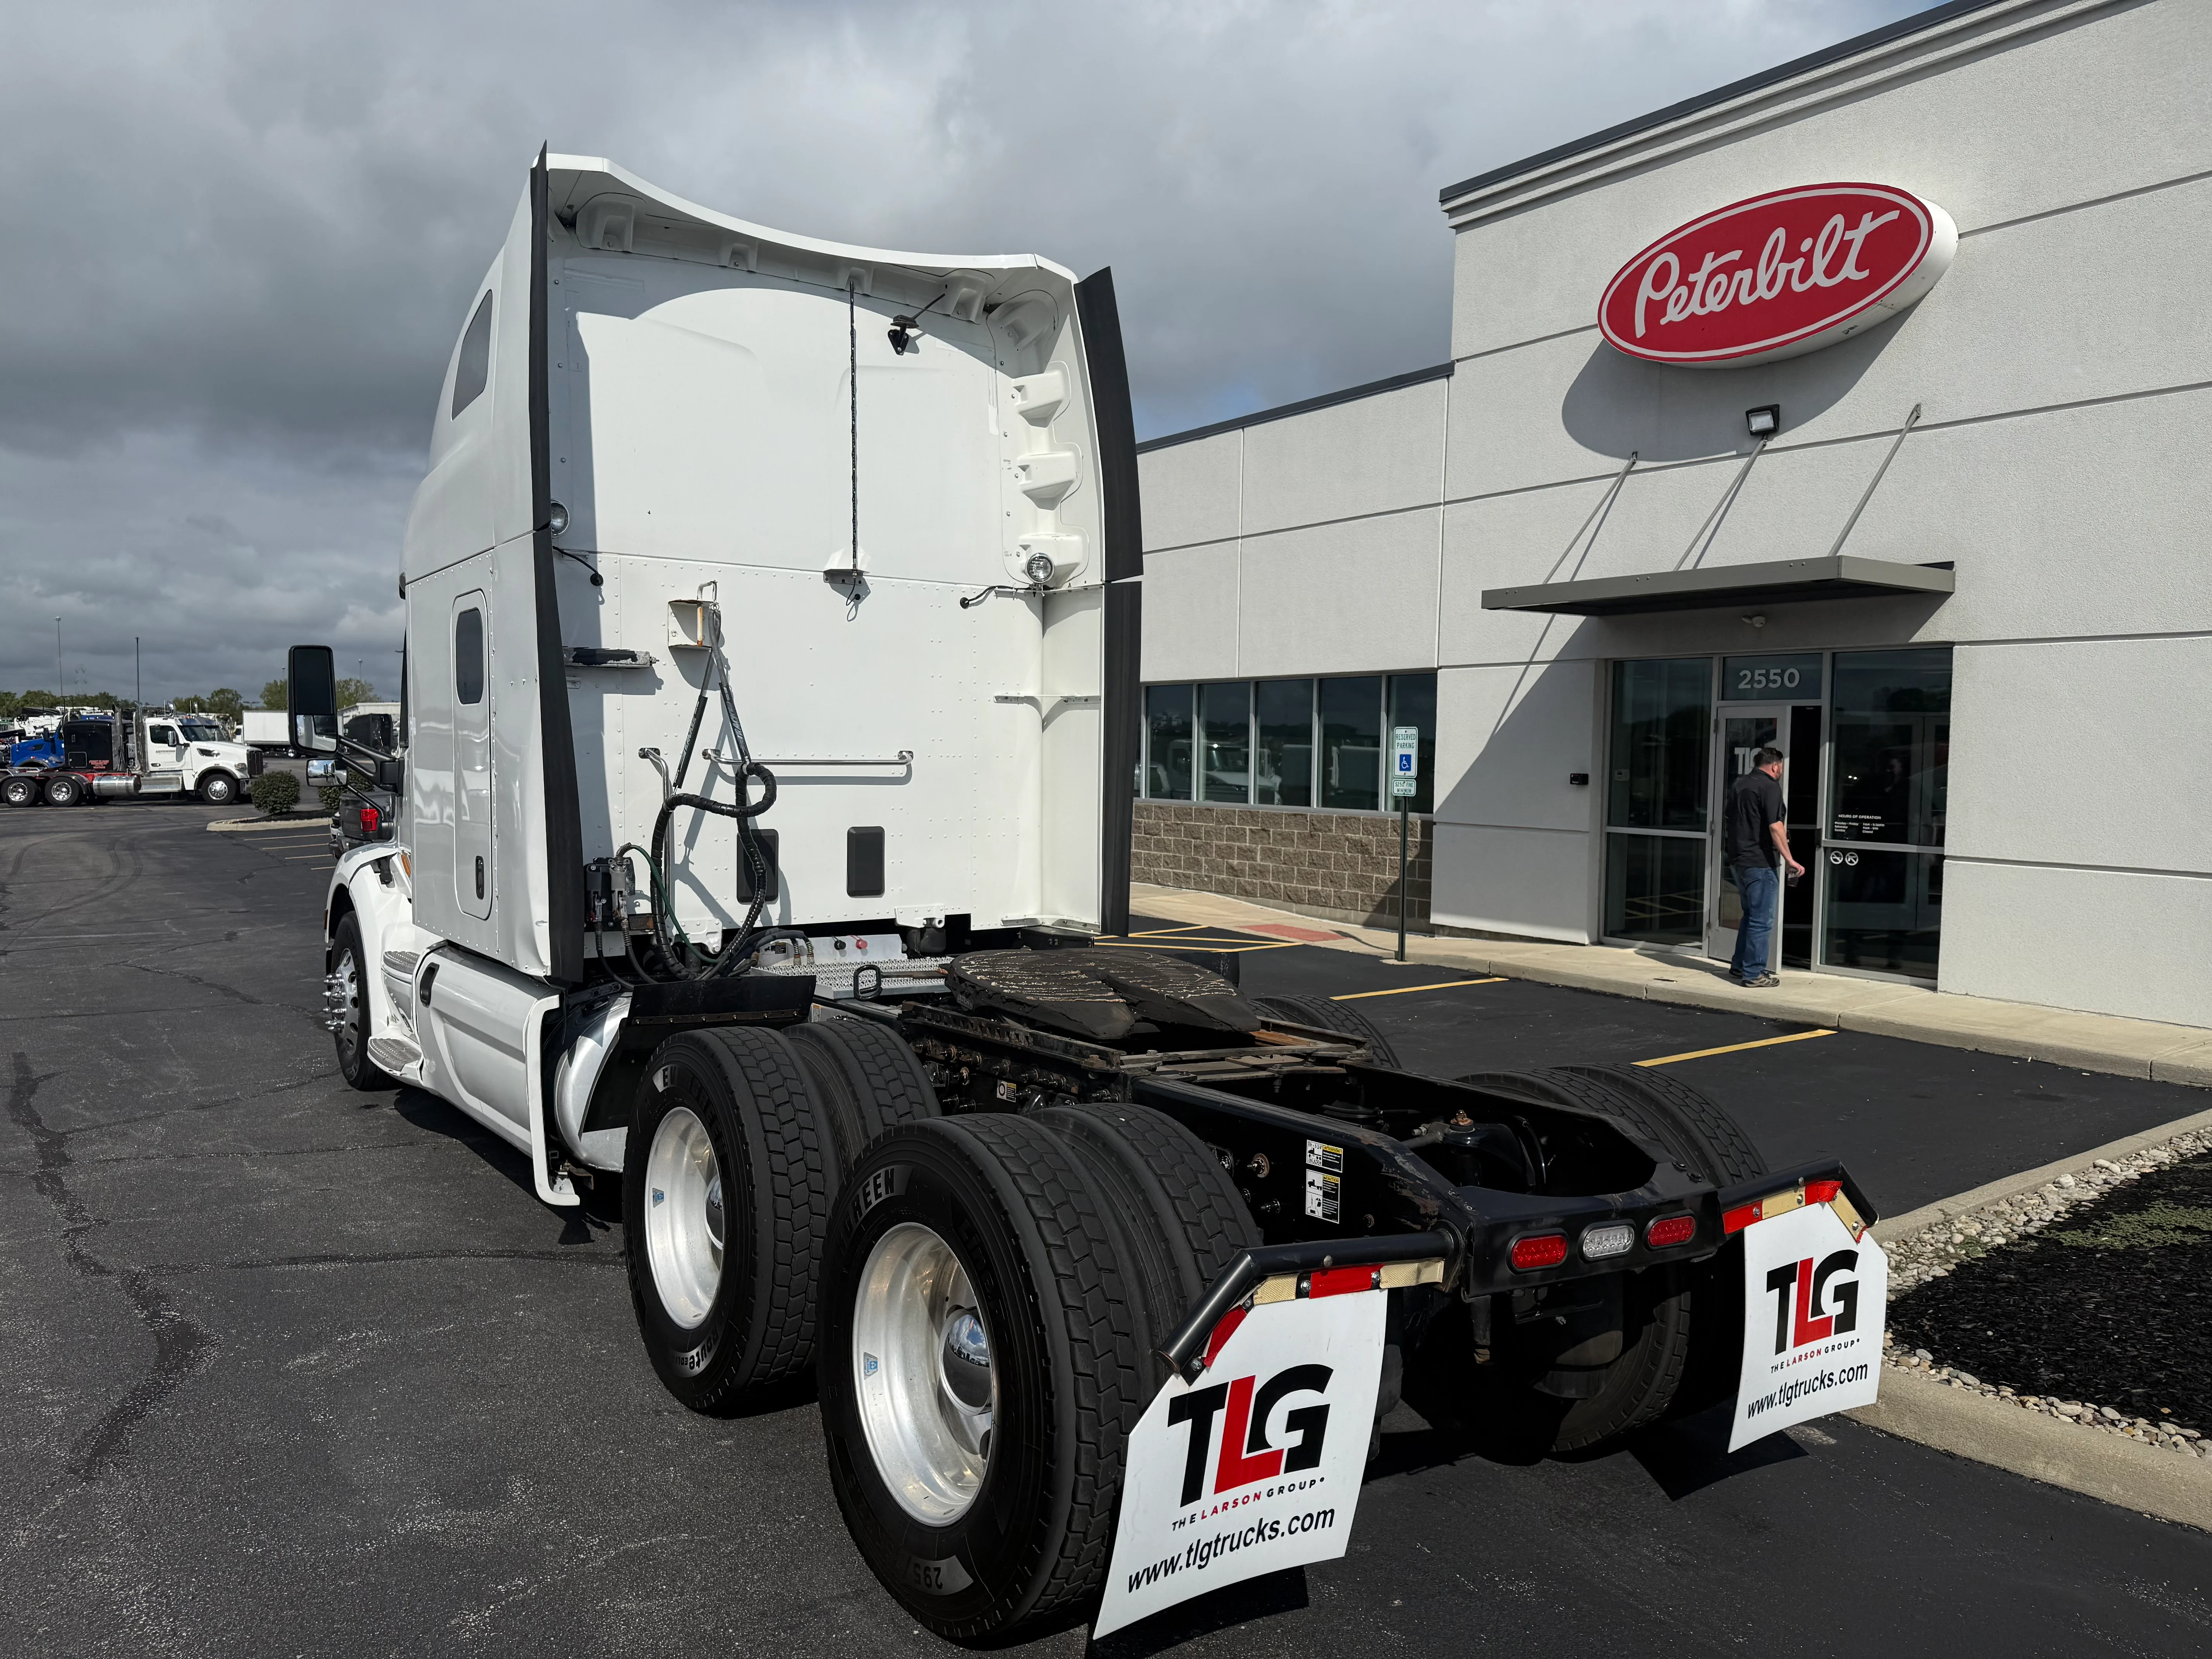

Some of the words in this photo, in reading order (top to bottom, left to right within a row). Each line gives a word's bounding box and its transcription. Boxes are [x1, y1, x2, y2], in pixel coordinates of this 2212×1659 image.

[1635, 210, 1900, 338] Peterbilt
[1738, 668, 1800, 690] 2550
[1766, 1249, 1859, 1356] TLG
[1748, 1364, 1868, 1419] www.tlgtrucks.com
[1771, 1361, 1784, 1374] THE
[1786, 1348, 1821, 1367] LARSON
[1167, 1364, 1334, 1508] TLG
[1172, 1513, 1197, 1531] THE
[1201, 1491, 1262, 1520] LARSON
[1128, 1508, 1335, 1594] www.tlgtrucks.com
